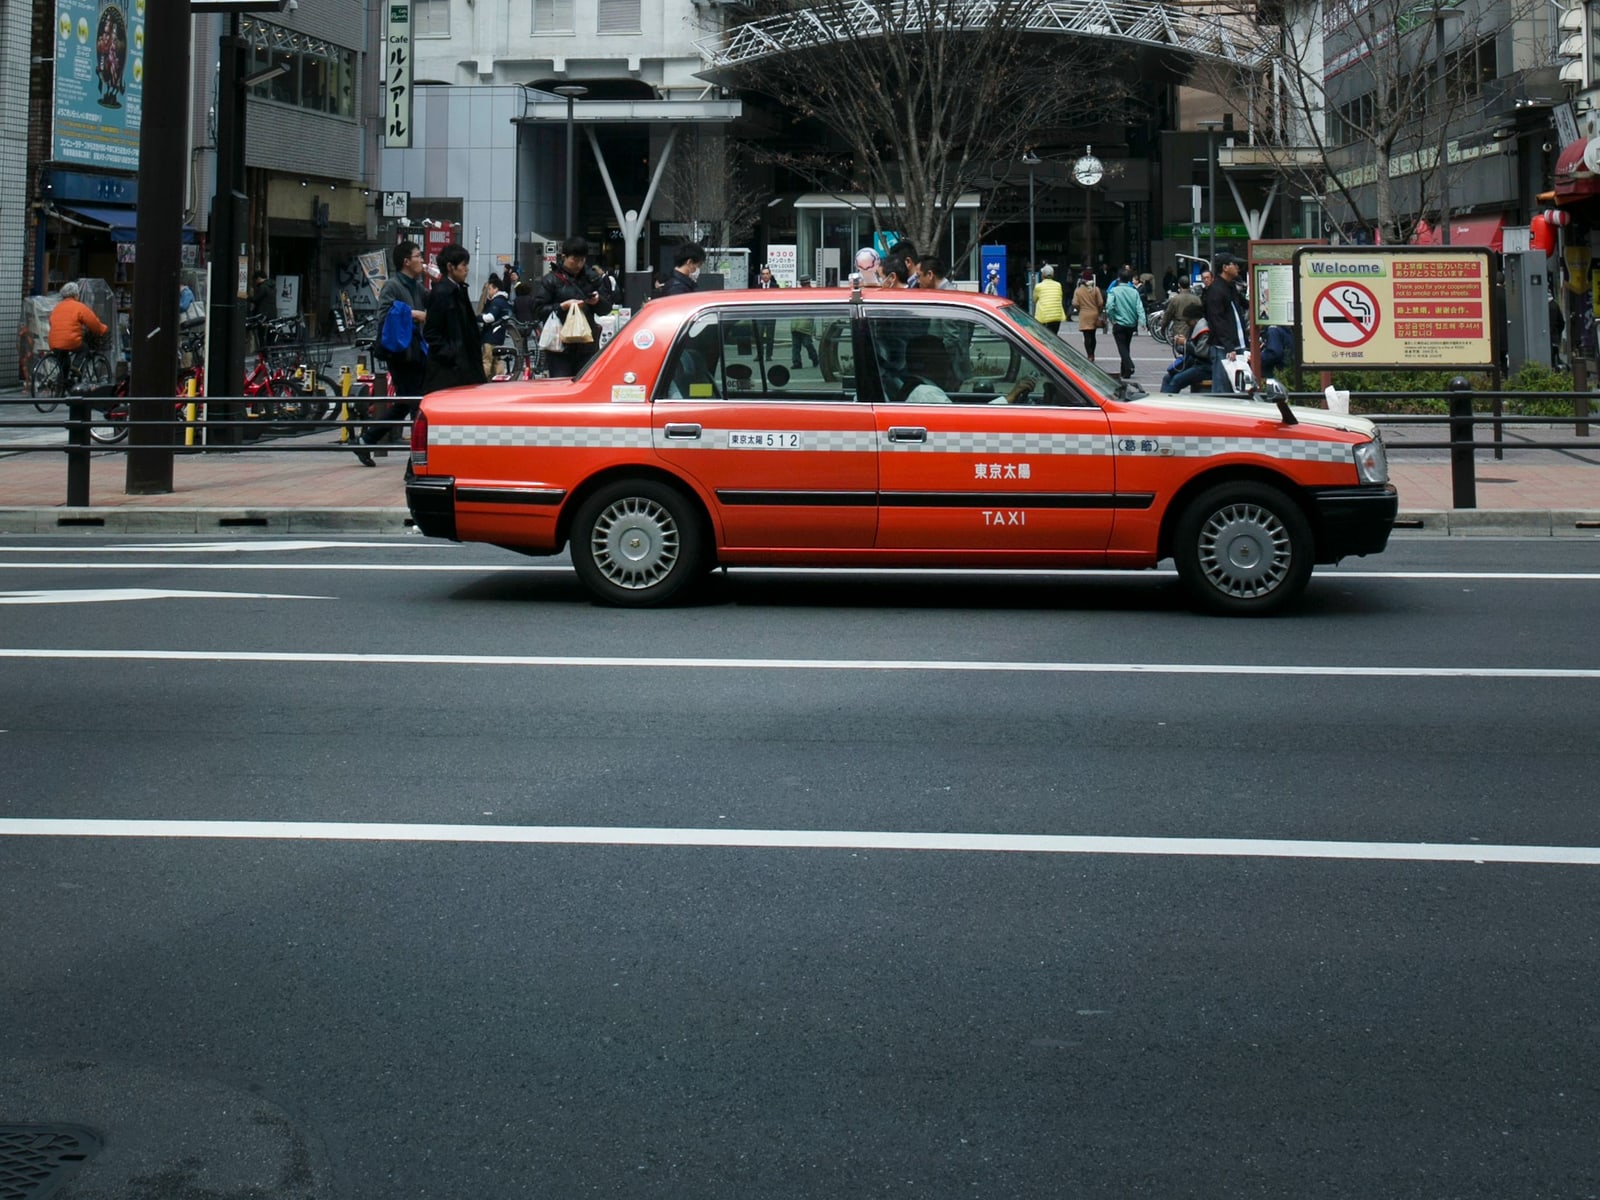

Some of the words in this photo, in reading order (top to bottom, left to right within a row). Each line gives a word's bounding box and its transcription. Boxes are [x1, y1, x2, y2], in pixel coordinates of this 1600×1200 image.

[389, 35, 408, 44] Cafe
[389, 47, 407, 138] ルノアール
[1311, 262, 1380, 273] Welcome
[731, 434, 763, 444] 東京太陽
[766, 434, 798, 447] 512
[974, 463, 1031, 479] 東京太陽
[981, 511, 1026, 526] TAXI
